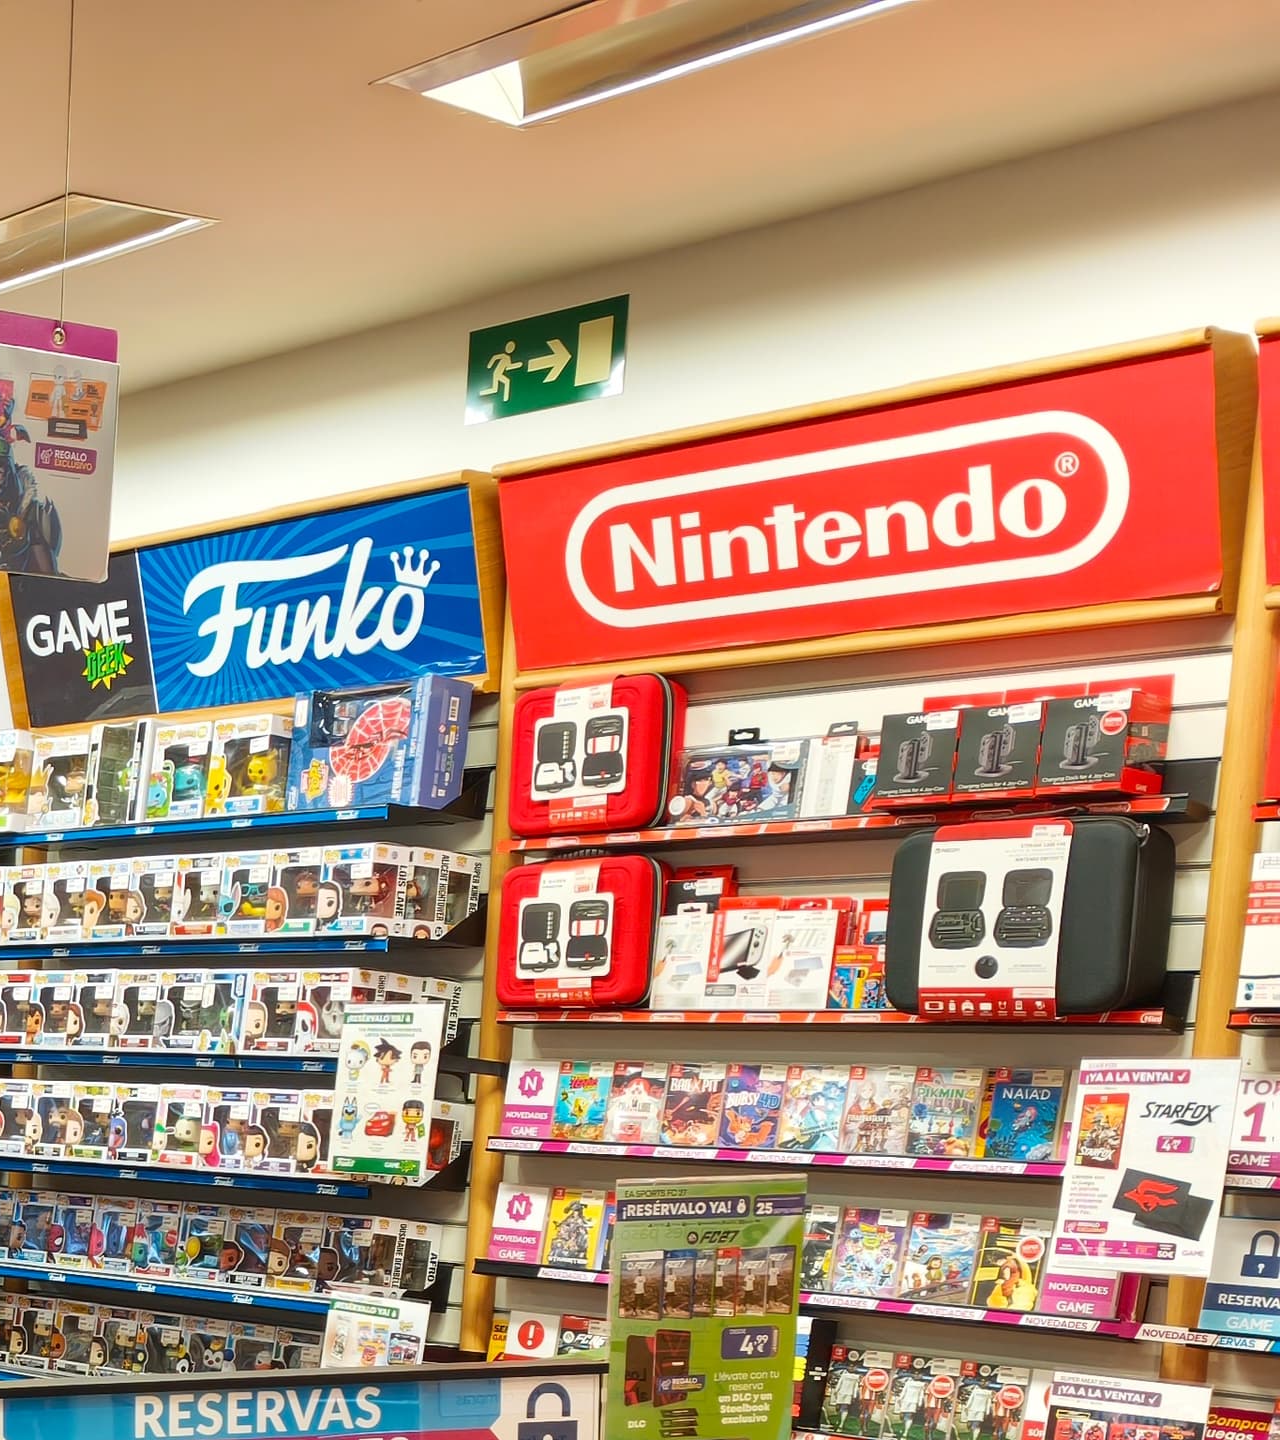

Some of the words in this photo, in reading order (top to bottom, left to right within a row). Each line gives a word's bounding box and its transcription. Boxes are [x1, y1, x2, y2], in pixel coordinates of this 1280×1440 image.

[54, 449, 87, 462] REGALO
[53, 459, 94, 471] EXCLUSIVO
[609, 464, 1069, 594] Nintendo
[183, 536, 429, 679] Funko
[26, 600, 134, 658] GAME
[86, 643, 129, 684] GEEK
[398, 865, 407, 890] LOIS
[395, 890, 406, 917] LANE
[1085, 1072, 1104, 1084] ¡YA
[1104, 1072, 1114, 1083] A
[1115, 1072, 1131, 1082] LA
[1132, 1072, 1174, 1083] VENTA!
[917, 1086, 966, 1100] PIKMIN
[1001, 1085, 1051, 1102] NAIAD
[505, 1112, 548, 1121] NOVEDADES
[1228, 1154, 1270, 1167] GAME
[622, 1200, 707, 1219] ¡RESÉRVALO
[709, 1201, 731, 1214] YA!
[756, 1202, 773, 1214] 25
[699, 1230, 740, 1244] FC27
[1047, 1281, 1109, 1295] NOVEDADES
[1142, 1329, 1208, 1343] NOVEDADES
[133, 1386, 382, 1440] RESERVAS
